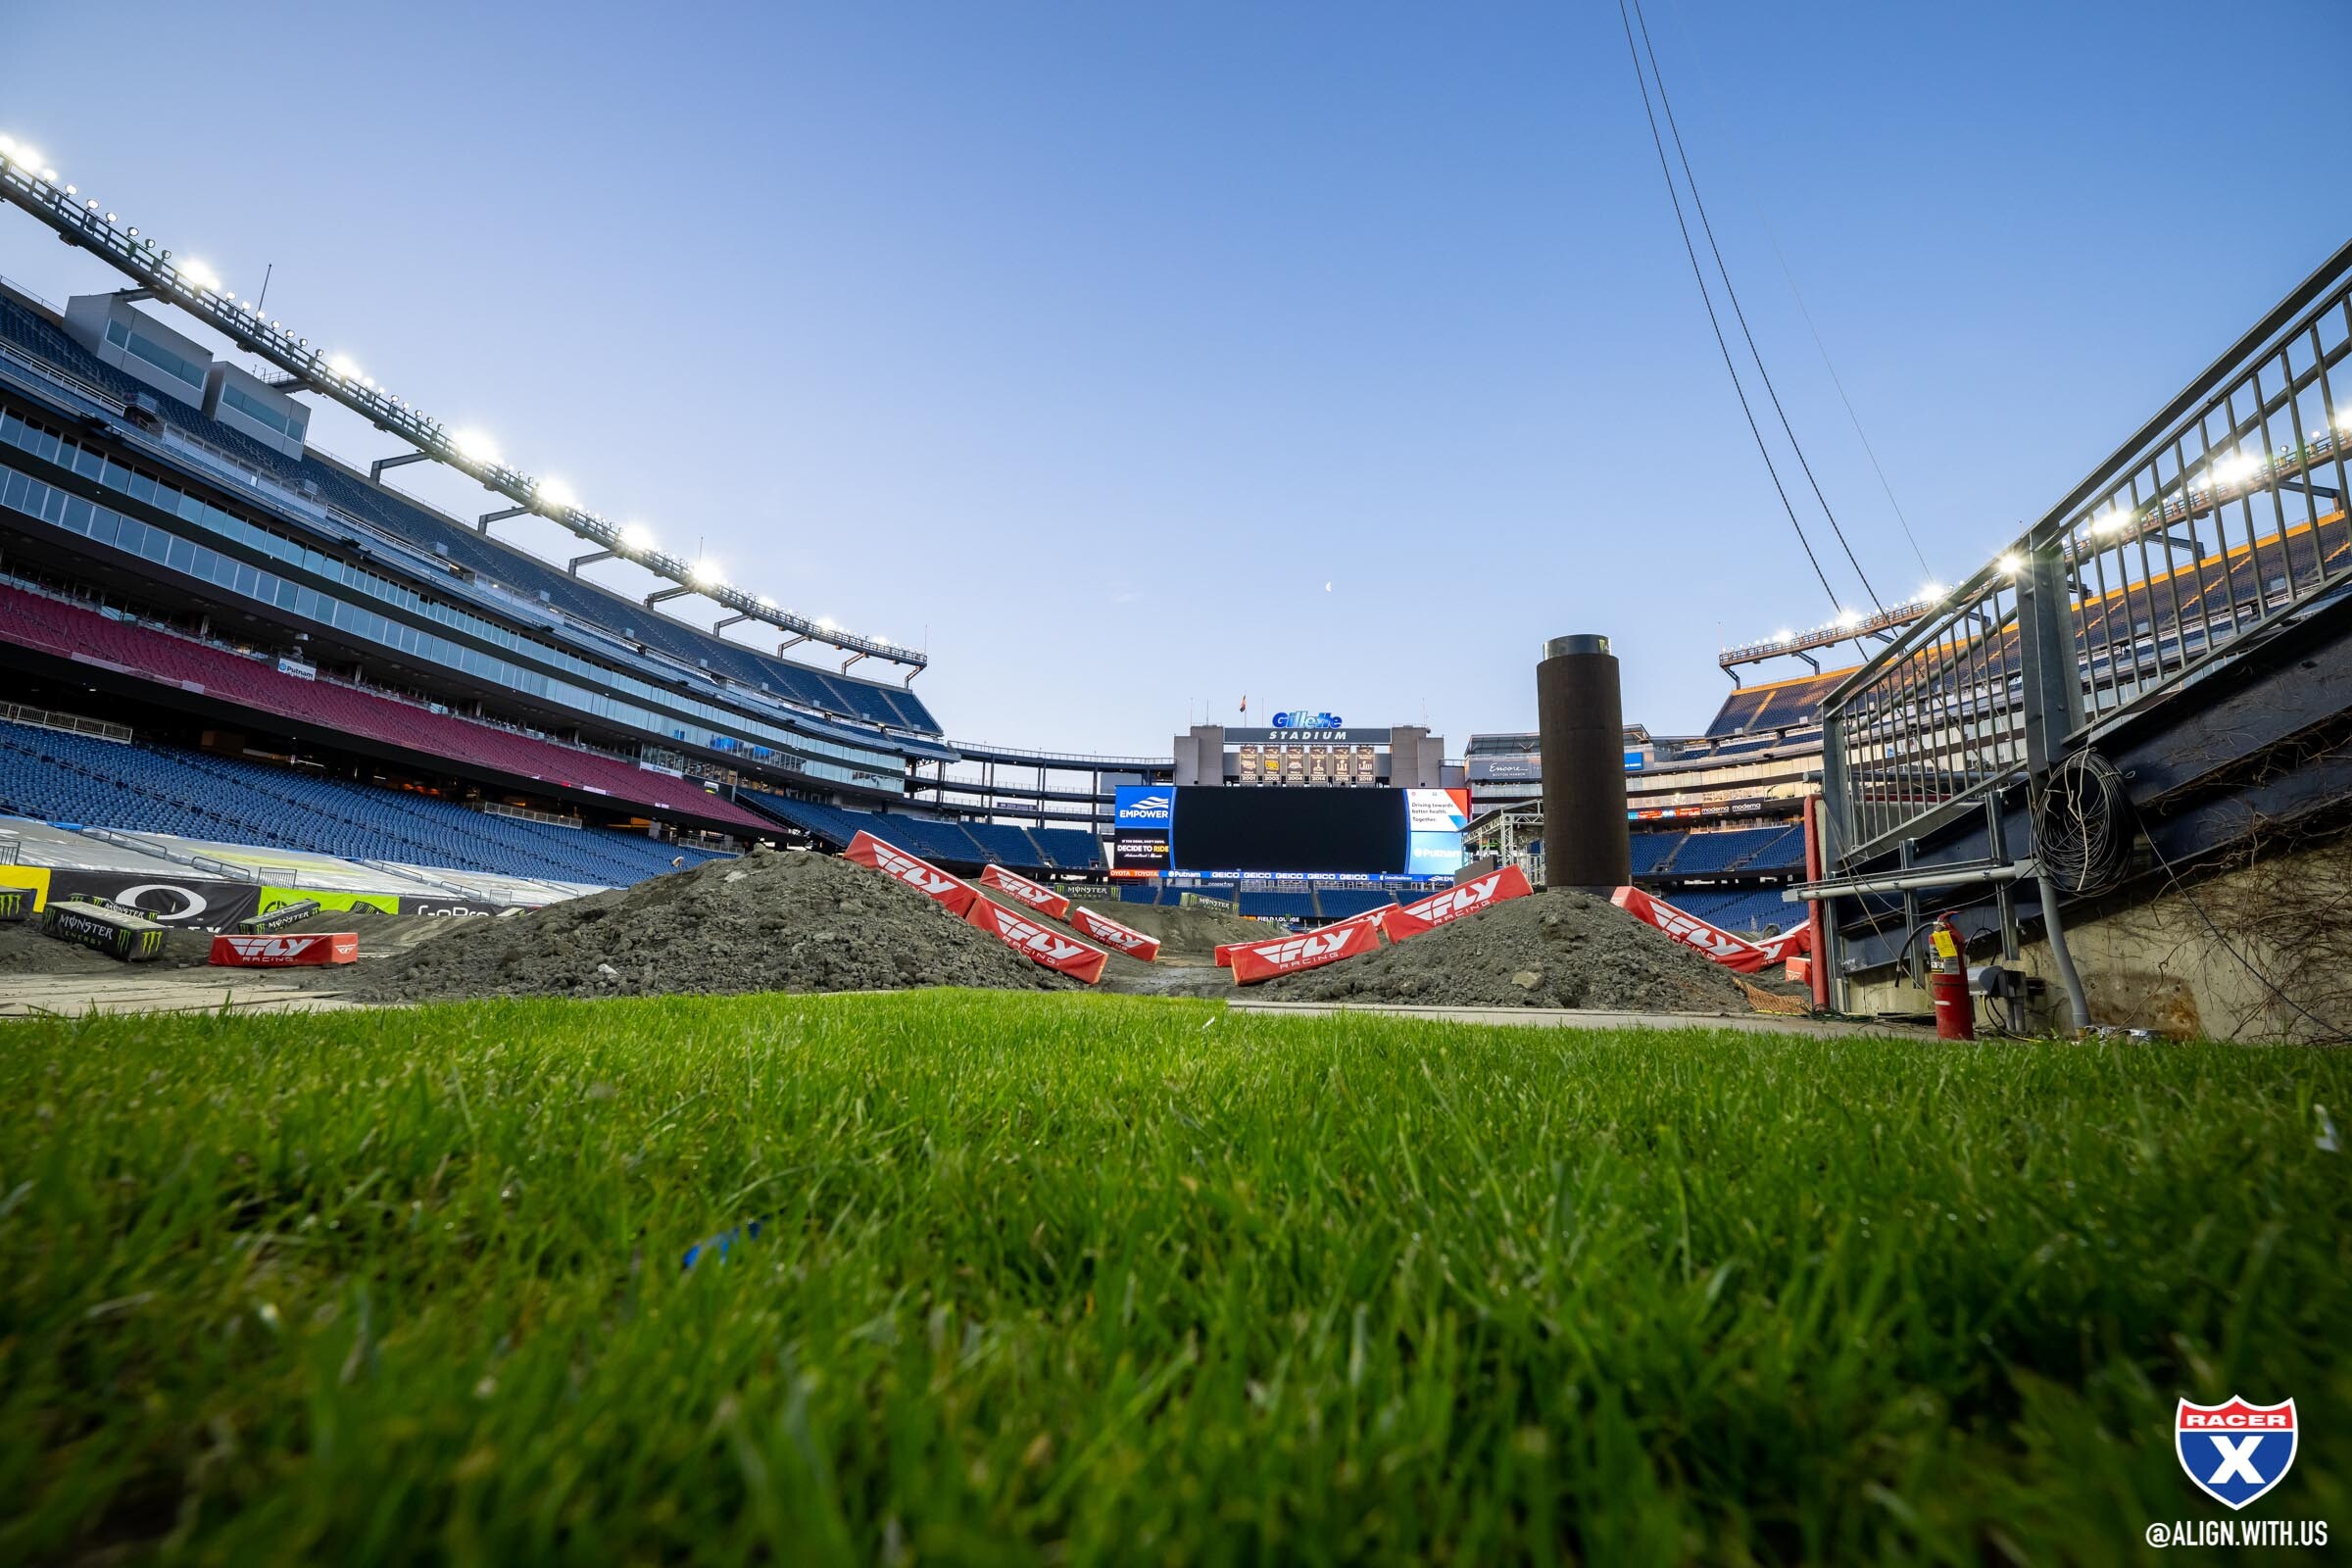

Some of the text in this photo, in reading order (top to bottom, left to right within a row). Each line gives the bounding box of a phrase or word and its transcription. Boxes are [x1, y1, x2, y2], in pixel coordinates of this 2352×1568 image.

[286, 665, 314, 678] Putnam
[1272, 710, 1343, 728] Gillette
[1269, 731, 1347, 740] STADIUM
[1489, 762, 1529, 772] Encore
[1119, 809, 1169, 818] EMPOWER
[872, 843, 958, 894] FLY
[997, 872, 1054, 904] FLY
[1068, 885, 1107, 895] MONSTER
[1403, 874, 1501, 921] FLY
[268, 910, 310, 930] MONSTER
[1434, 900, 1491, 926] RACING
[59, 913, 114, 941] MONSTER
[994, 908, 1085, 959] FLY
[1086, 916, 1145, 948] FLY
[1649, 900, 1746, 956] FLY
[227, 938, 315, 956] FLY
[1002, 935, 1055, 965] RACING
[1252, 928, 1354, 963] FLY
[1280, 953, 1339, 970] RACING
